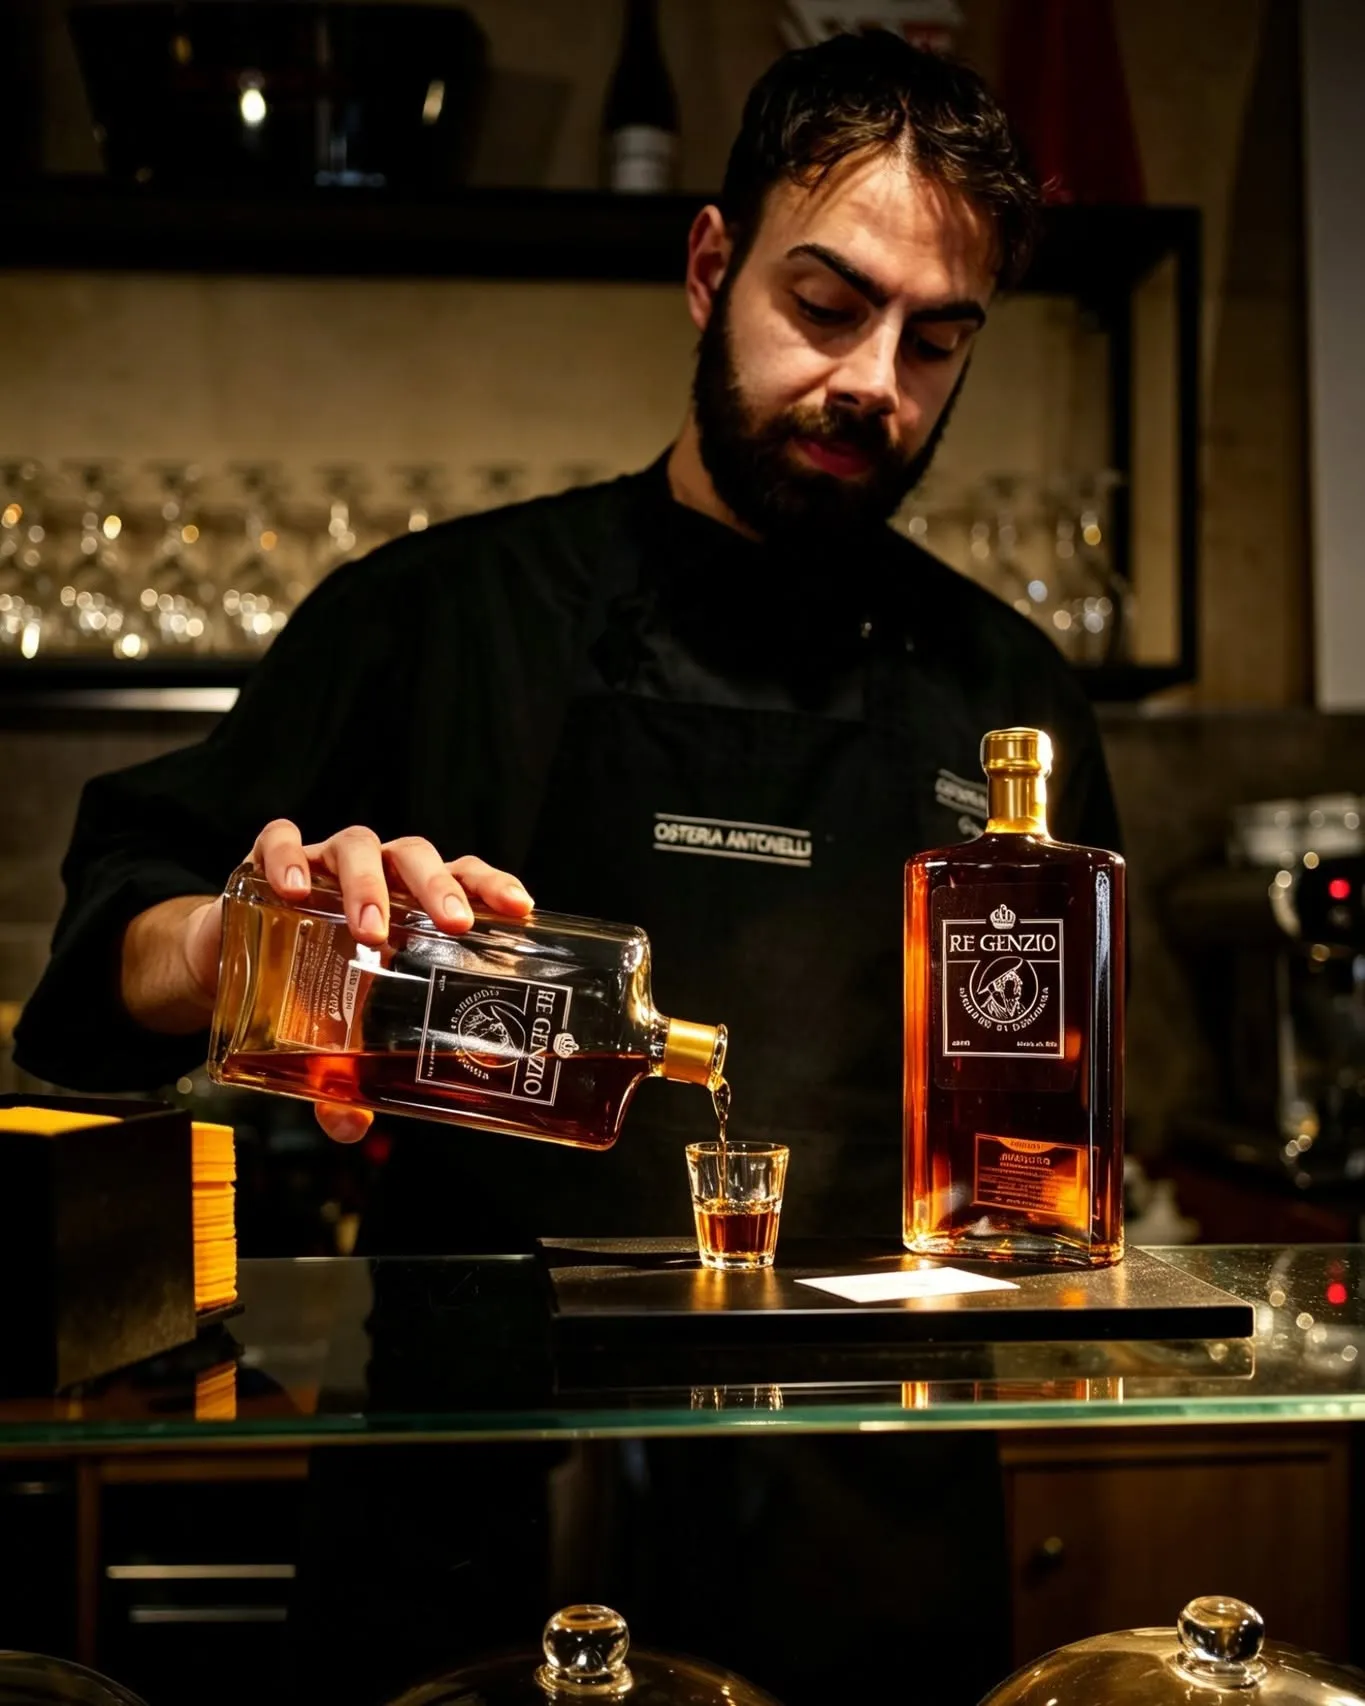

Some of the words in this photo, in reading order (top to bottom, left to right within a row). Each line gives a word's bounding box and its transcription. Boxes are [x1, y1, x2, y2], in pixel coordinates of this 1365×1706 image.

[654, 822, 723, 847] OSTERIA
[726, 830, 812, 858] ANTONELLI
[949, 934, 975, 952] RE
[980, 934, 1056, 952] GENZIO
[535, 989, 556, 1015] RE
[523, 1017, 551, 1095] GENZIO
